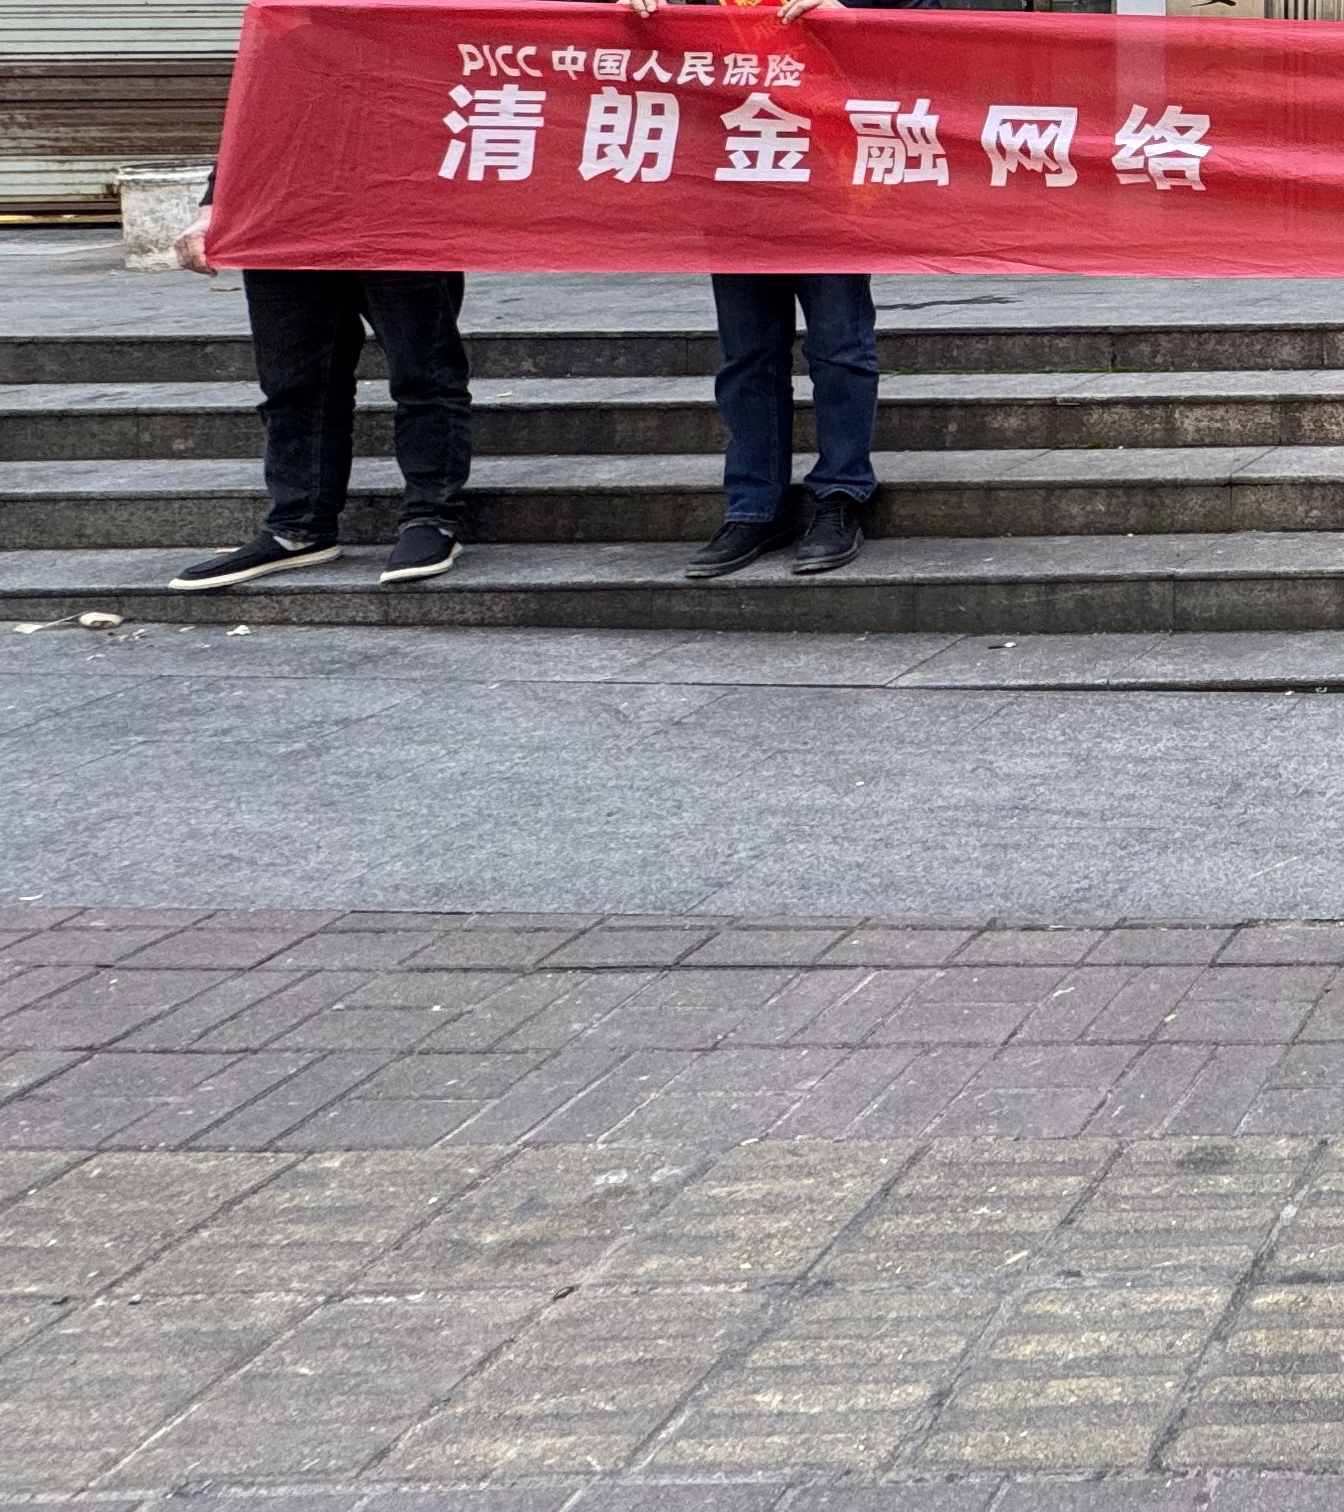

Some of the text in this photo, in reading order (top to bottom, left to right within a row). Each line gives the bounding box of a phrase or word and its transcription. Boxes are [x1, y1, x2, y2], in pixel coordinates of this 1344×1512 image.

[457, 43, 806, 88] PICC 中国人民保险
[437, 82, 1213, 192] 清朗金融网络
